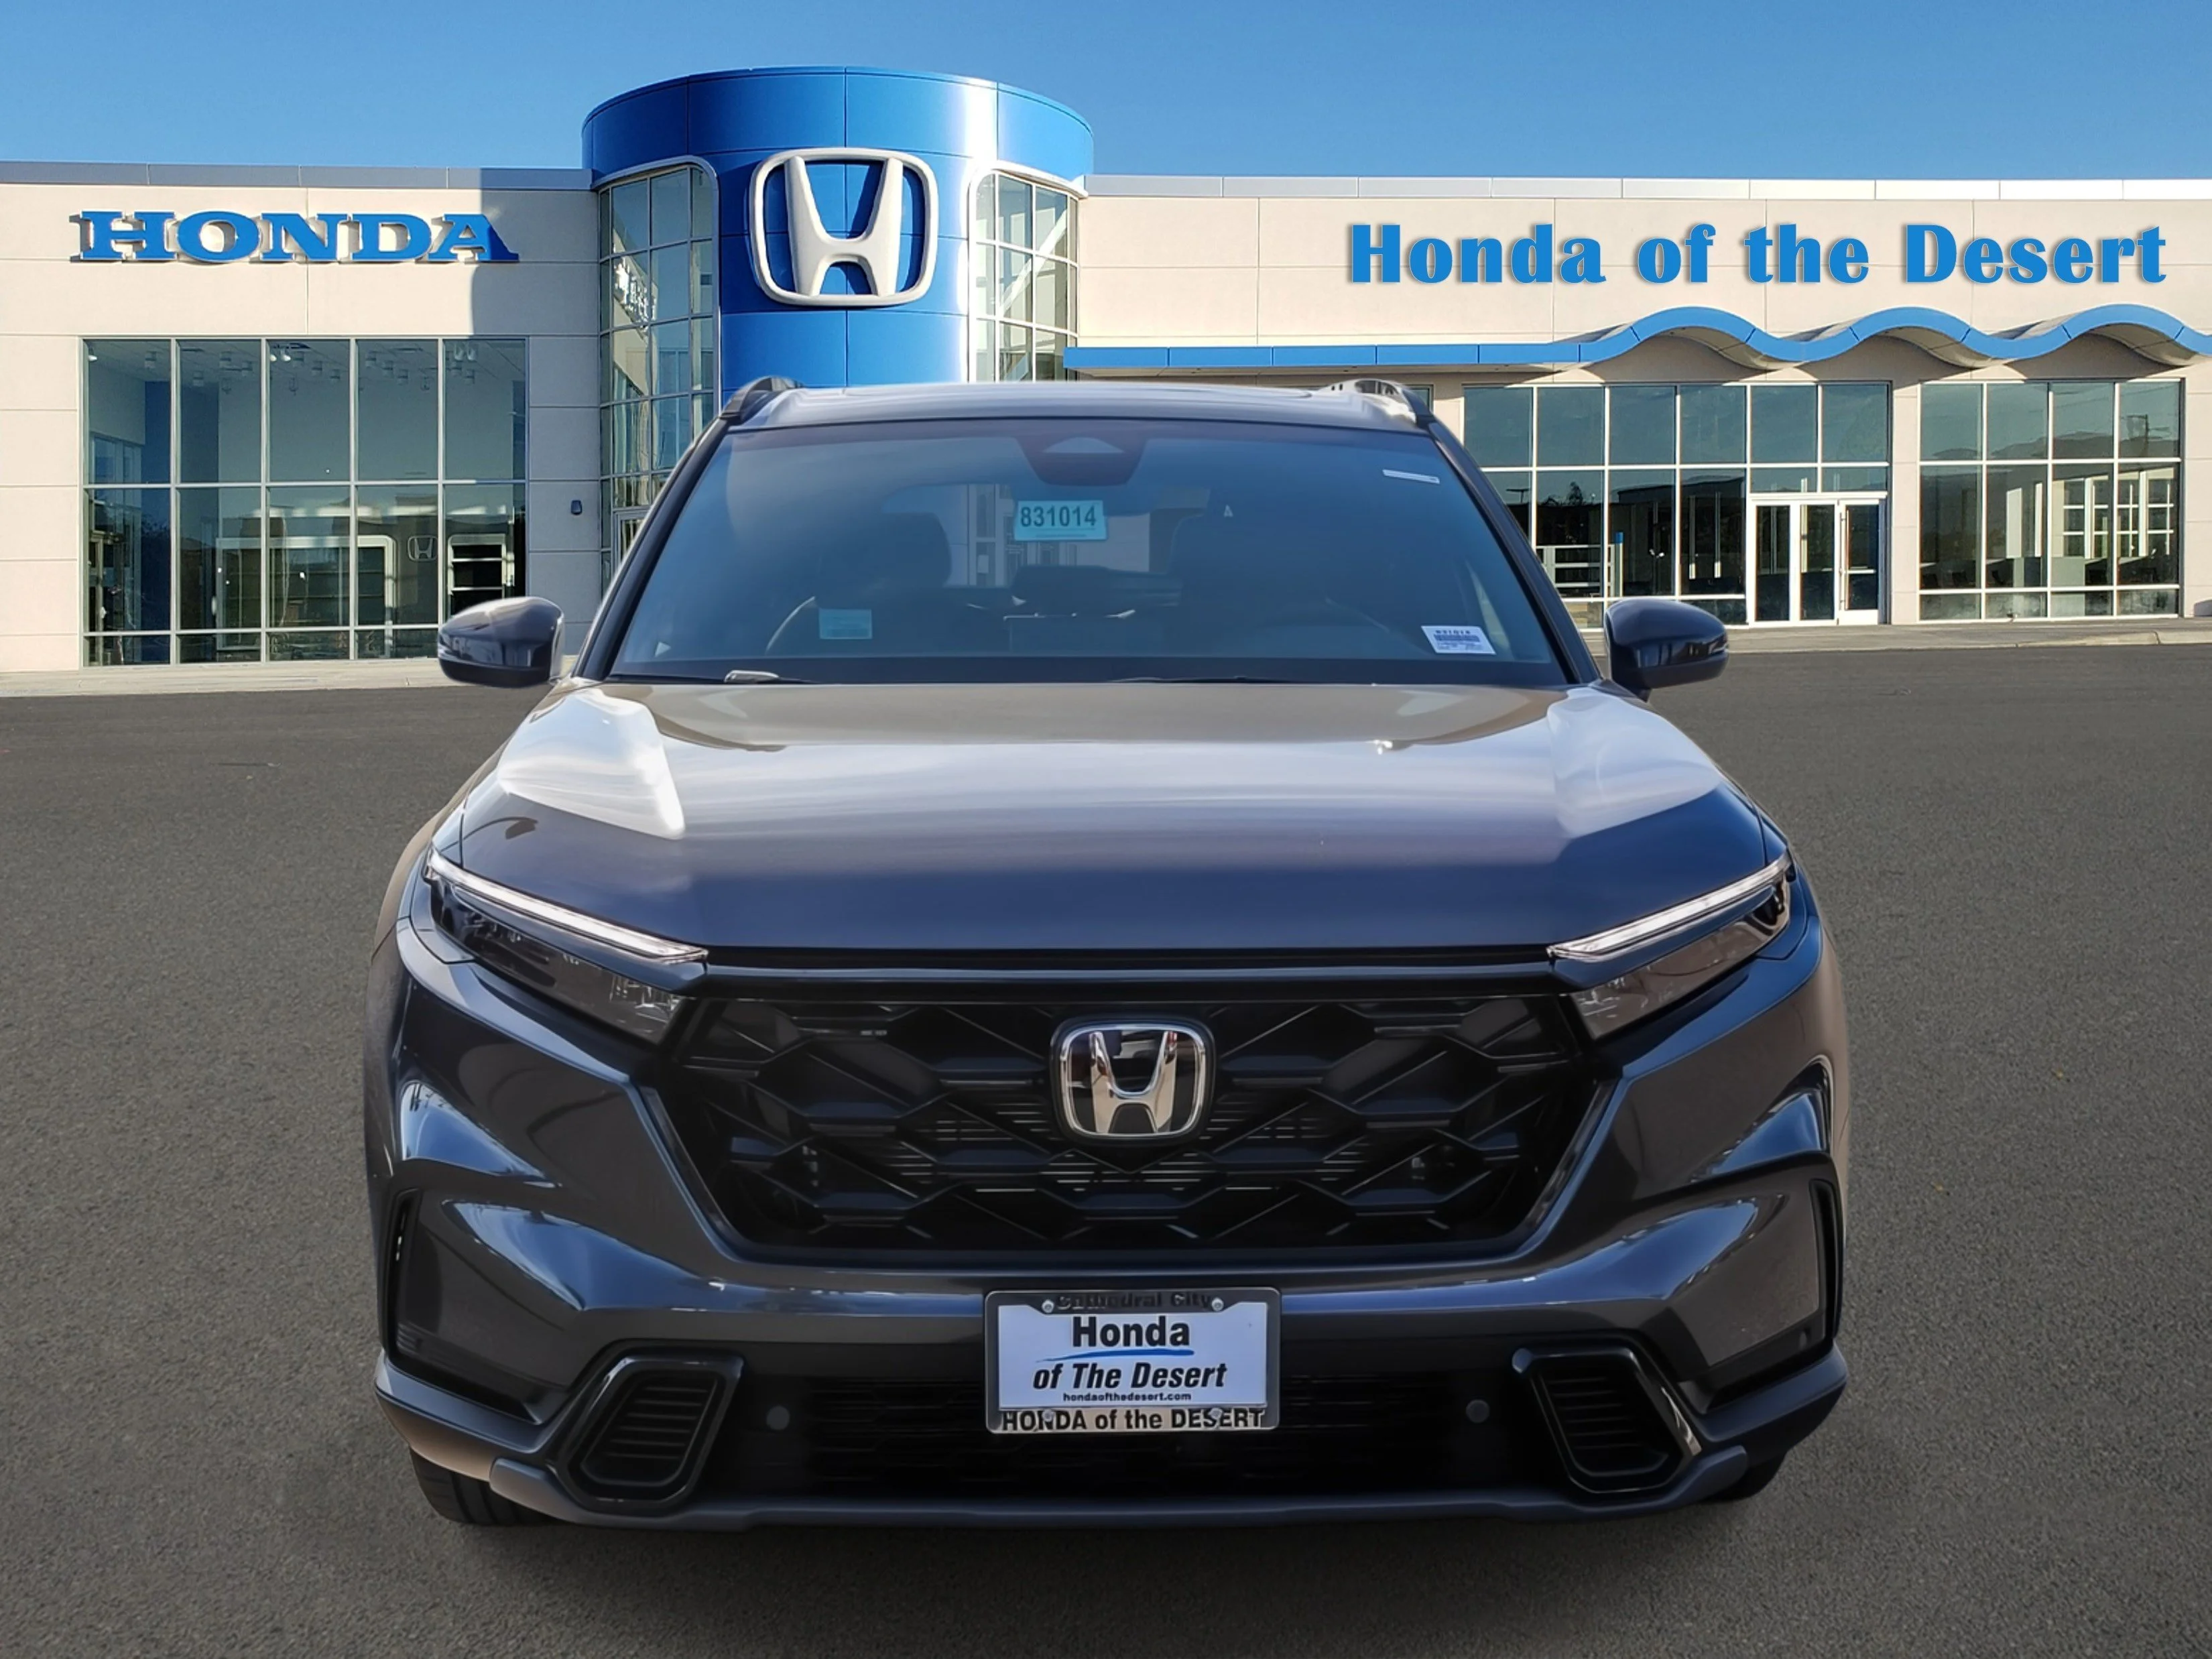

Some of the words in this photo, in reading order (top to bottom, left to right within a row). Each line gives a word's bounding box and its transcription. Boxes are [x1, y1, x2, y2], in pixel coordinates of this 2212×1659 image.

[80, 210, 519, 263] HONDA
[1351, 223, 1607, 284] Honda
[1638, 223, 1716, 284] of
[1743, 223, 1869, 284] the
[1906, 224, 2167, 284] Desert
[1020, 506, 1097, 528] 831014
[1170, 1294, 1211, 1309] City
[1072, 1316, 1190, 1347] Honda
[1033, 1363, 1064, 1390] of
[1072, 1363, 1121, 1389] The
[1131, 1363, 1227, 1389] Desert
[1062, 1392, 1192, 1402] hondaofthedesert.com
[1002, 1409, 1087, 1431] HONDA
[1095, 1409, 1118, 1430] of
[1124, 1409, 1163, 1429] the
[1170, 1408, 1266, 1429] DESERT
